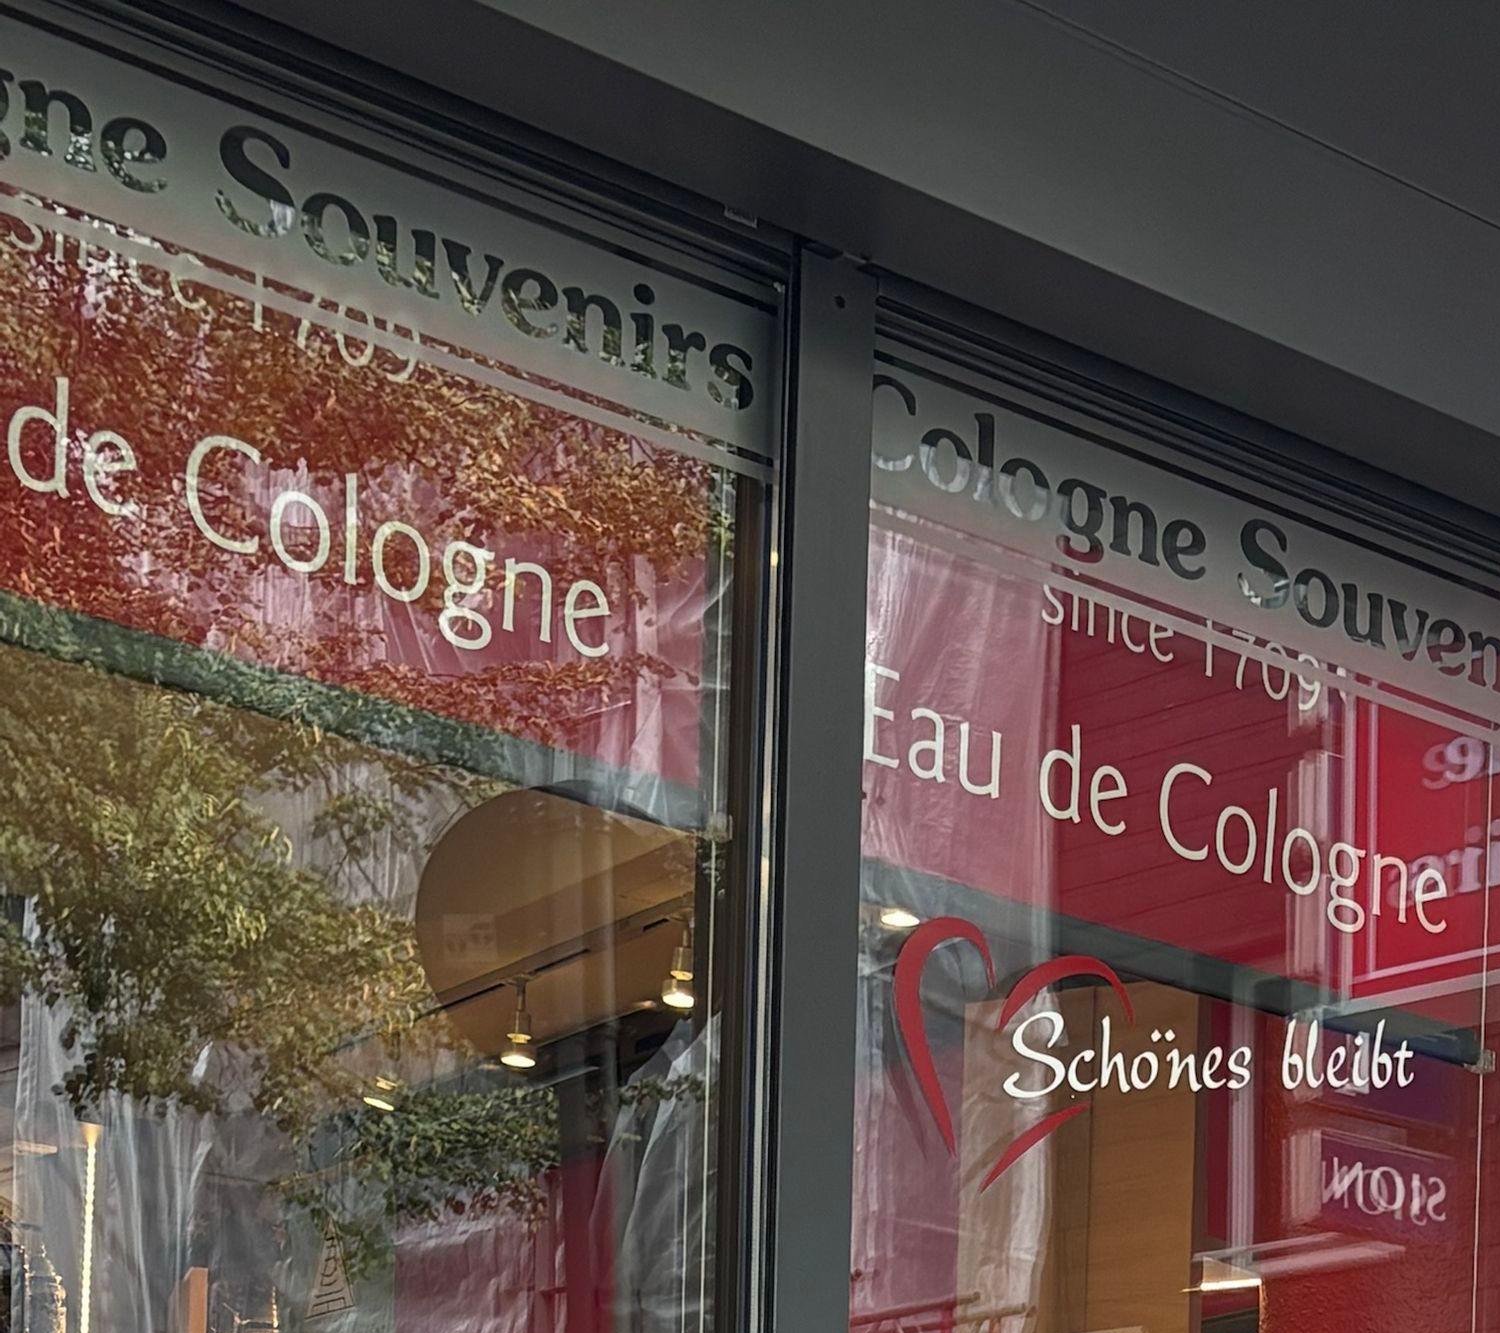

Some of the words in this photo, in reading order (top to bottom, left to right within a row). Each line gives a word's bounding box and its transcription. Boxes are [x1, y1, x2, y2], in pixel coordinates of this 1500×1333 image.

[214, 125, 754, 411] Souvenirs
[8, 378, 137, 517] de
[187, 435, 611, 658] Cologne
[873, 374, 1206, 580] Cologne
[1041, 574, 1175, 663] since
[863, 662, 1002, 800] Eau
[1039, 724, 1127, 837] de
[1158, 762, 1448, 934] Cologne
[1002, 1010, 1252, 1099] Schönes
[1281, 1017, 1415, 1090] bleibt
